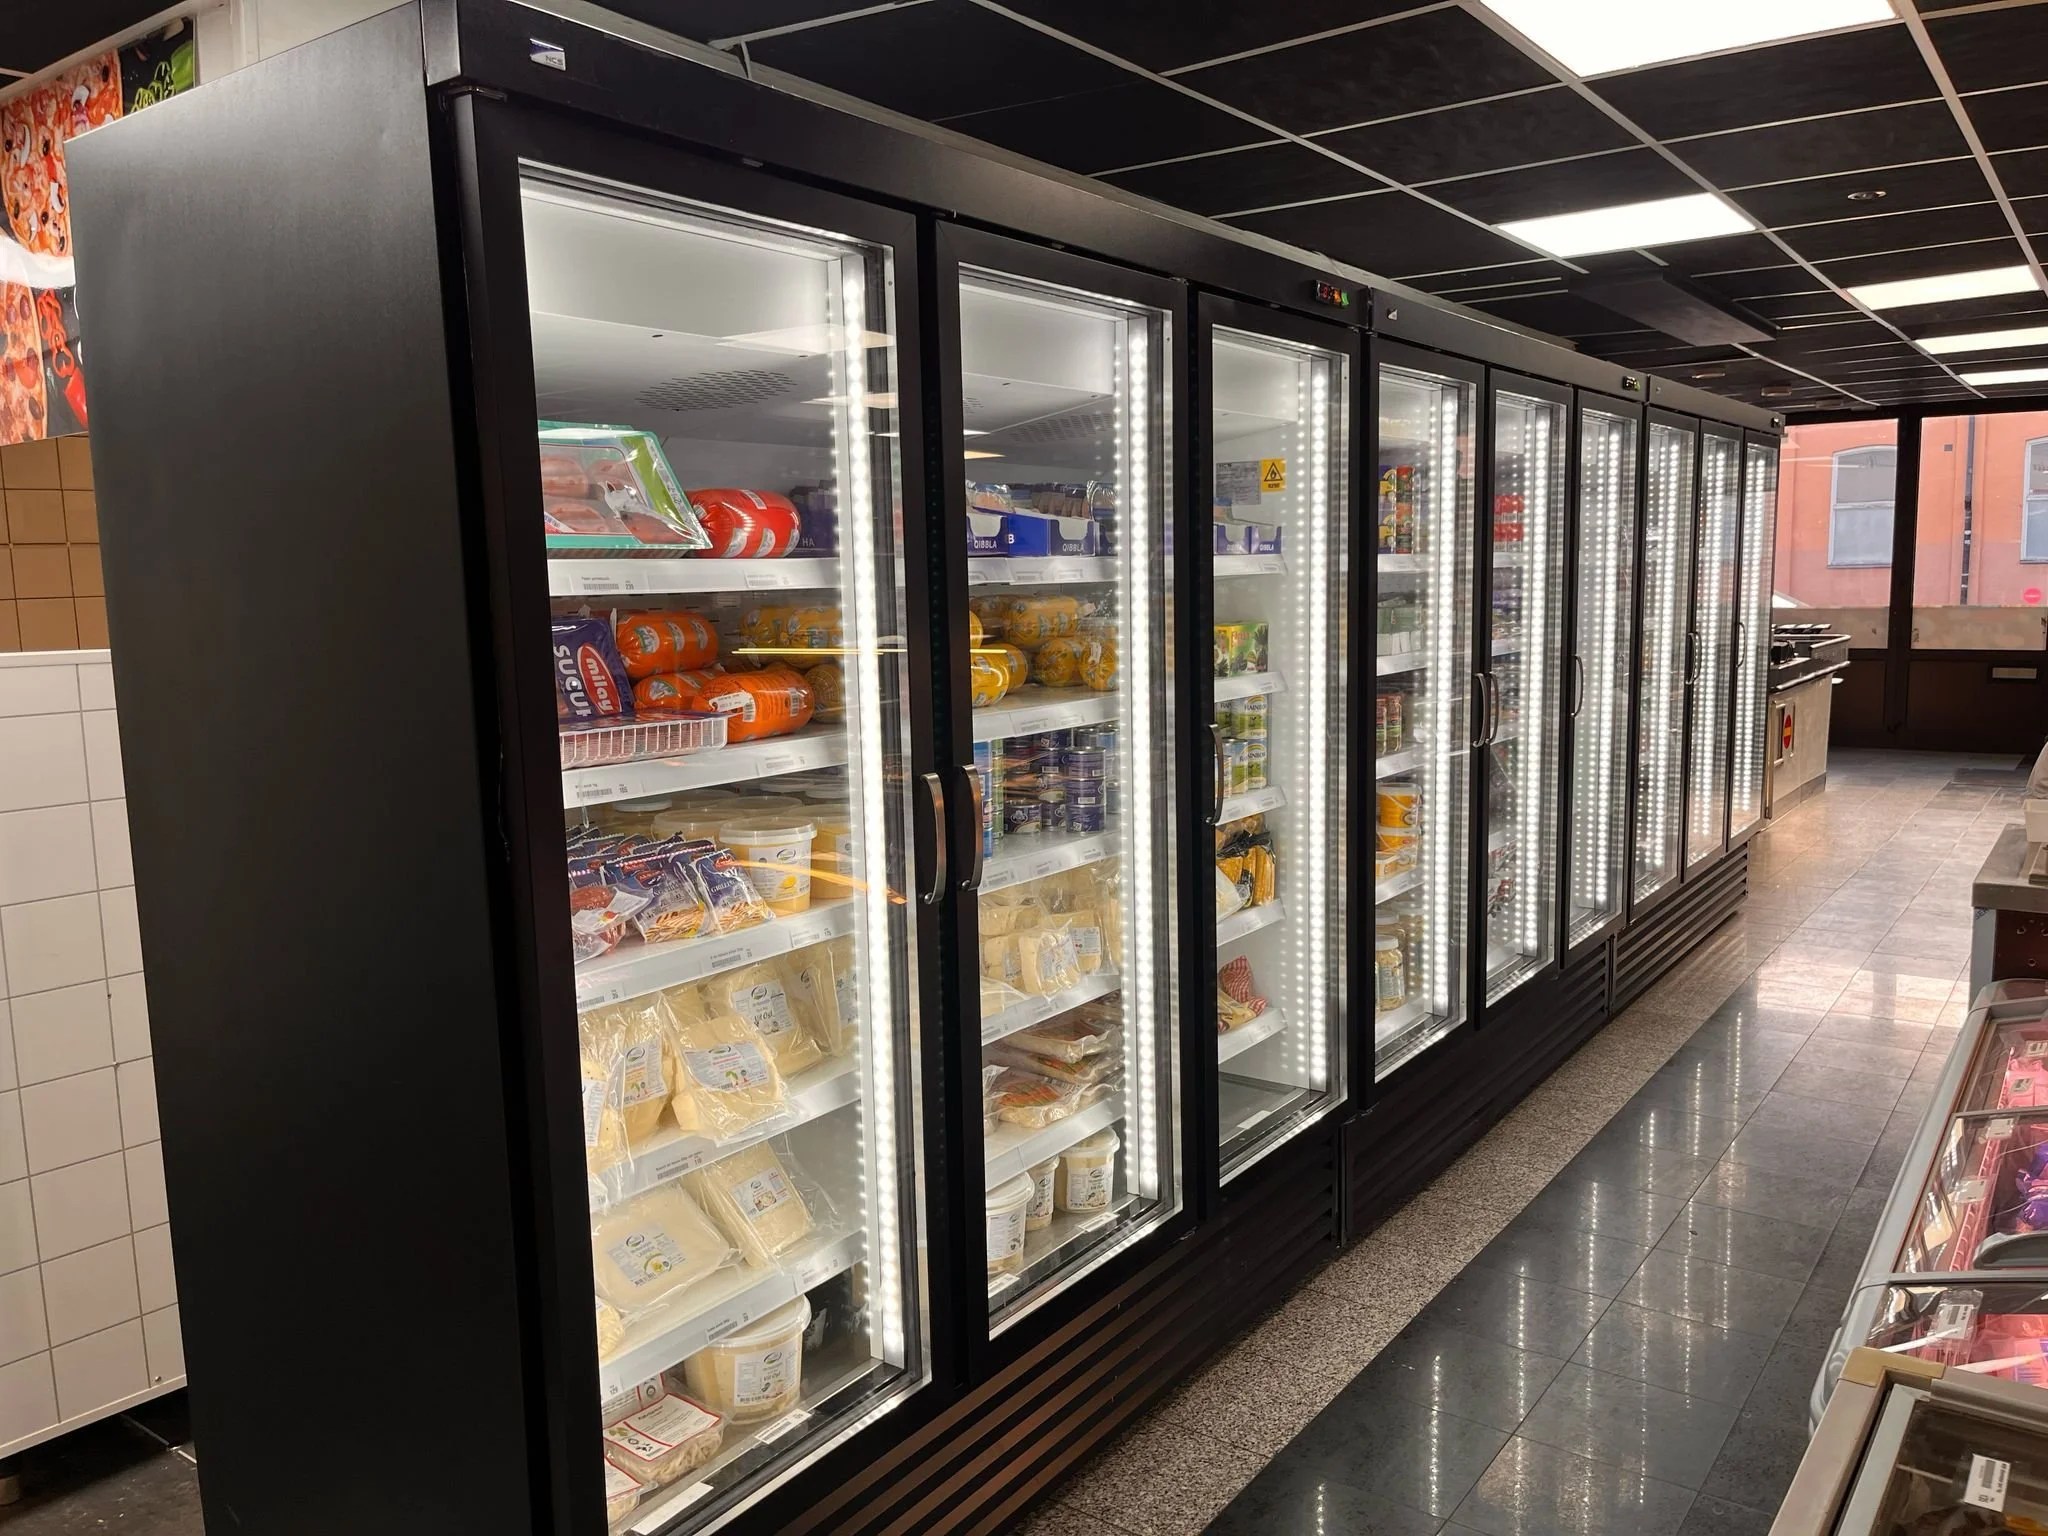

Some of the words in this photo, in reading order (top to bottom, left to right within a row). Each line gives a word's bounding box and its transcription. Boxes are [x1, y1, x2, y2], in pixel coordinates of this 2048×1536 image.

[974, 540, 997, 549] QIBBLA
[1062, 543, 1084, 552] QIBBLA
[586, 658, 614, 711] milay
